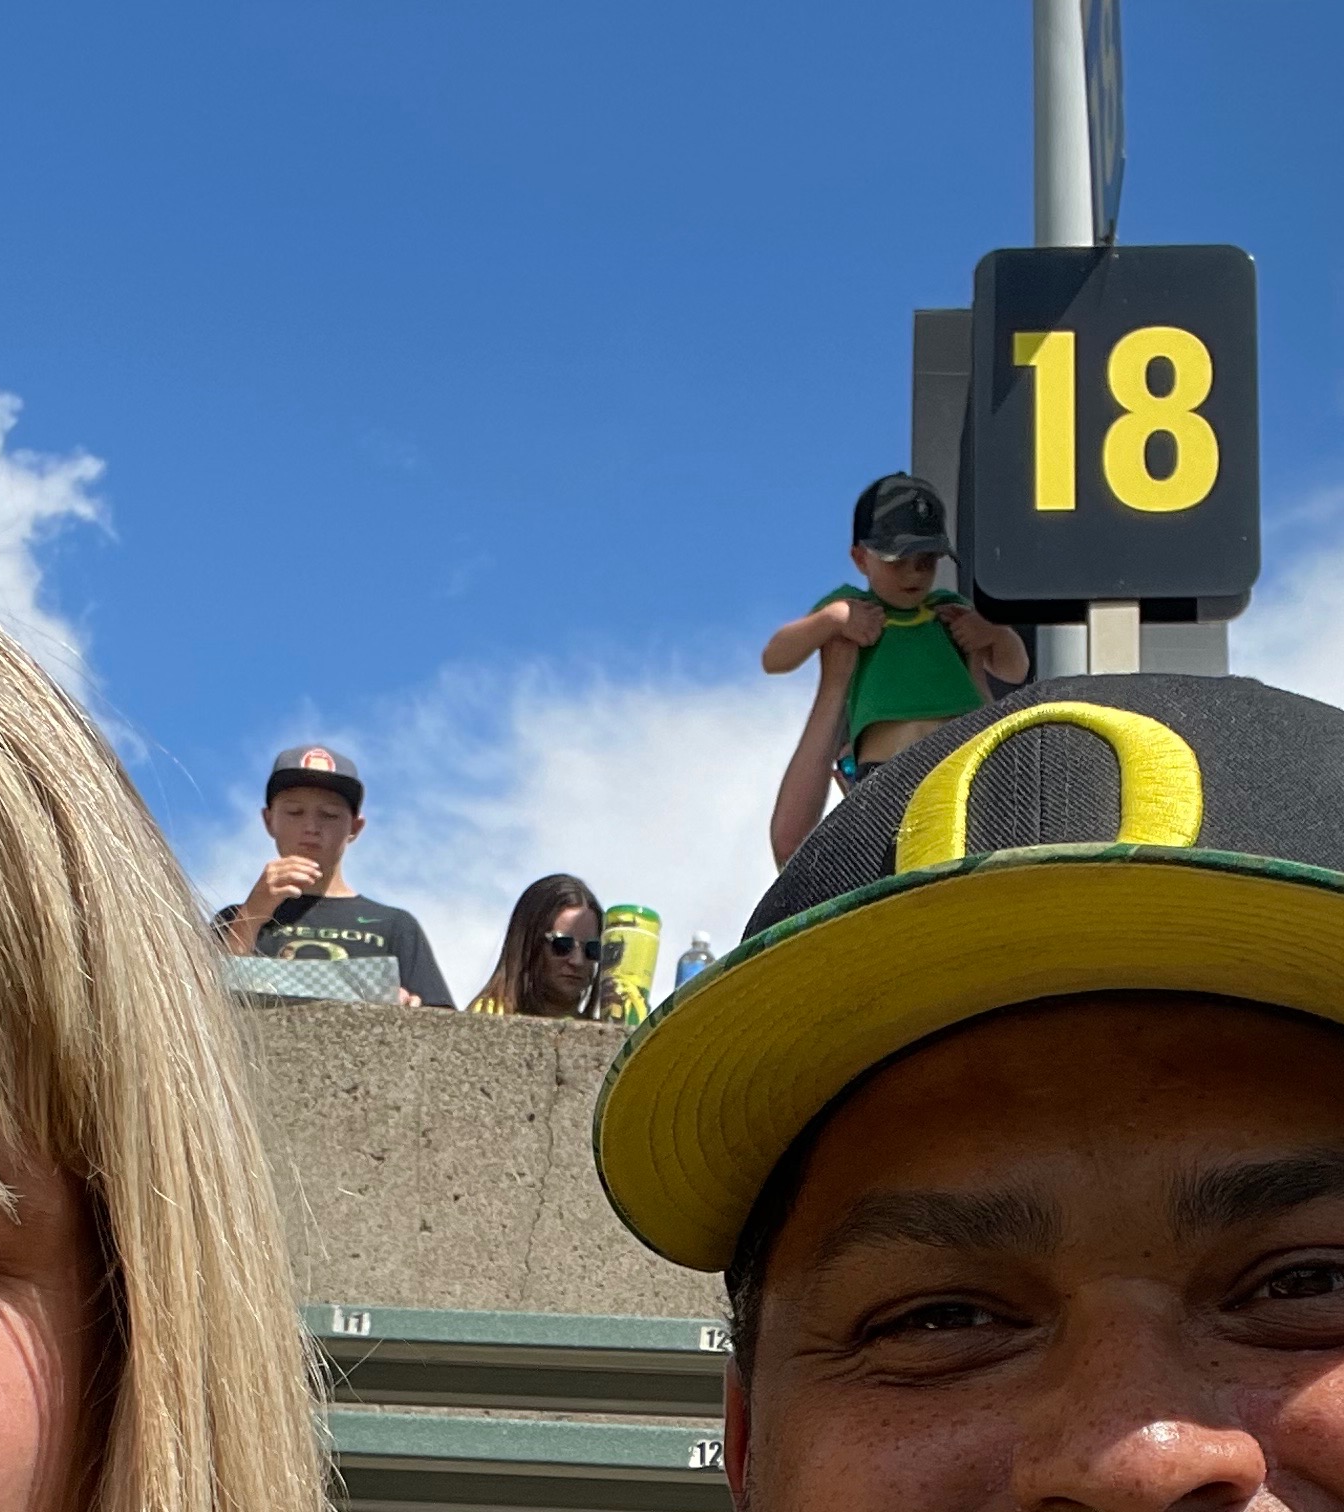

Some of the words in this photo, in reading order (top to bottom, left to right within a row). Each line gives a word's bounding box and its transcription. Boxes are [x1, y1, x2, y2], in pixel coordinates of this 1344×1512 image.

[1013, 326, 1219, 511] 18
[260, 926, 384, 947] REGON
[697, 1441, 722, 1466] 12
